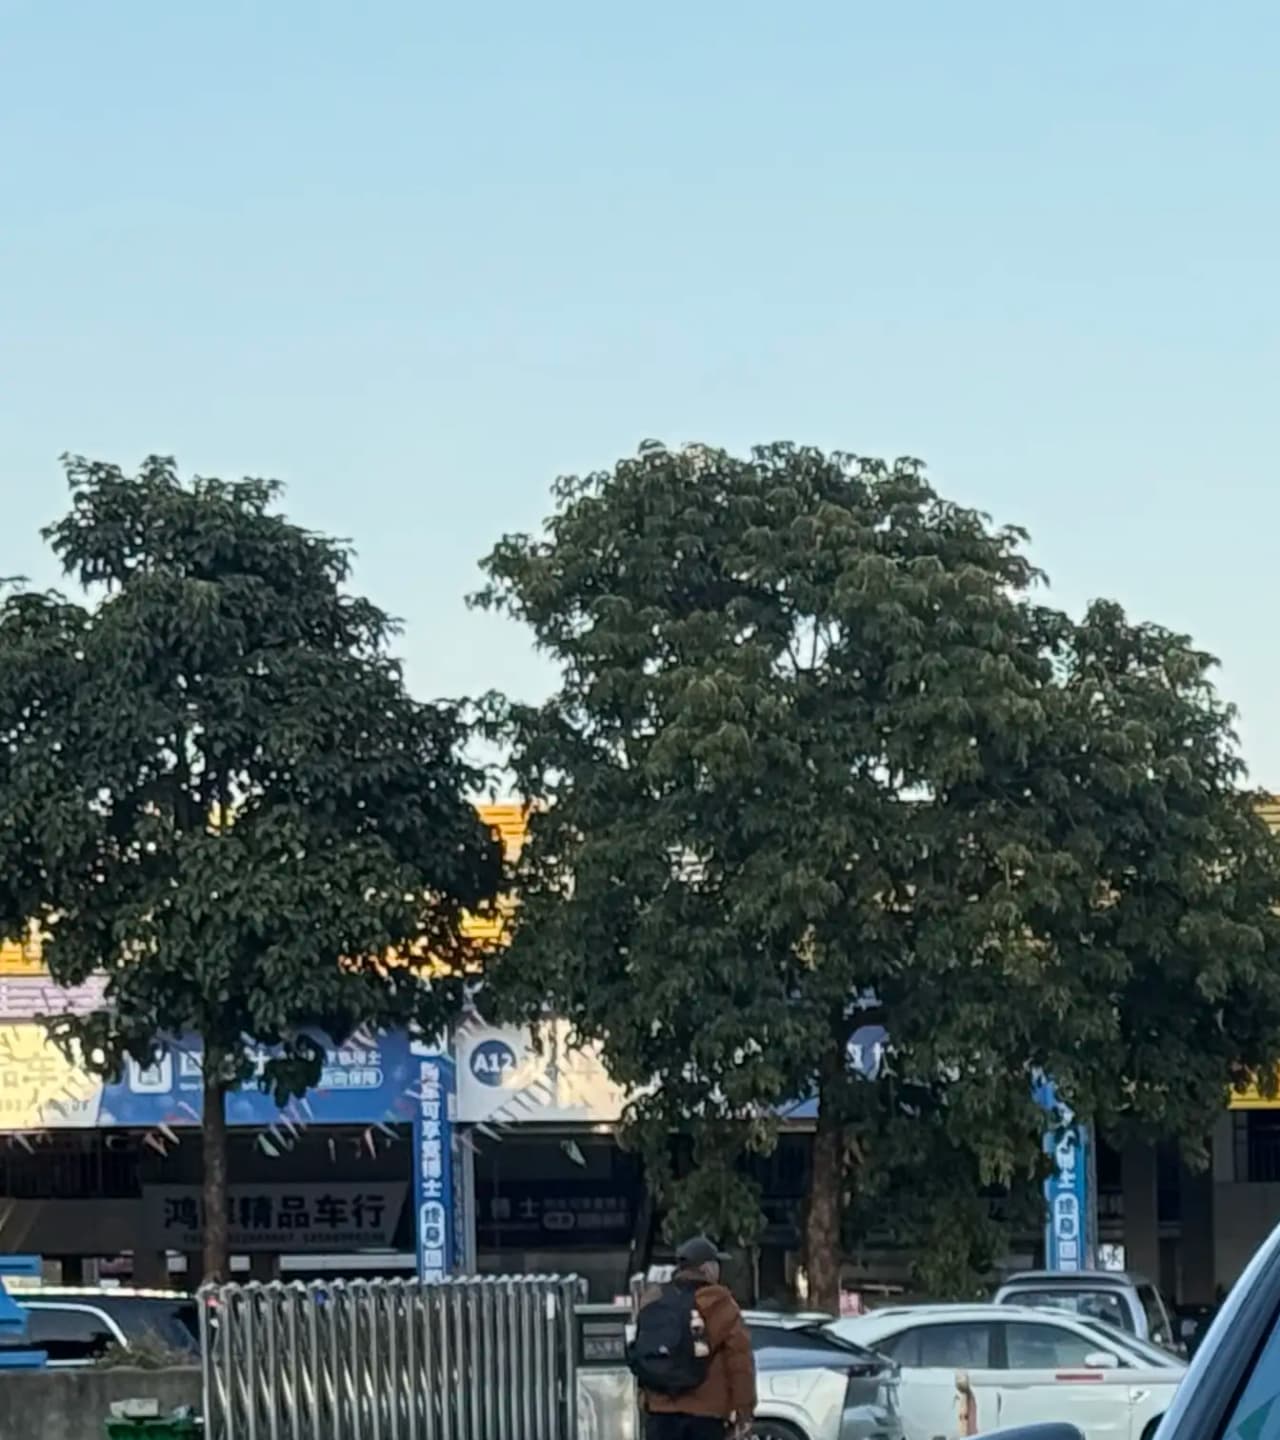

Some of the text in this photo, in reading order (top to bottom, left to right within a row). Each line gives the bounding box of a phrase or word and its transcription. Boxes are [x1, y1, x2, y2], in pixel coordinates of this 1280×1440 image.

[474, 1053, 513, 1073] A12
[164, 1195, 386, 1230] 鸿精品车行
